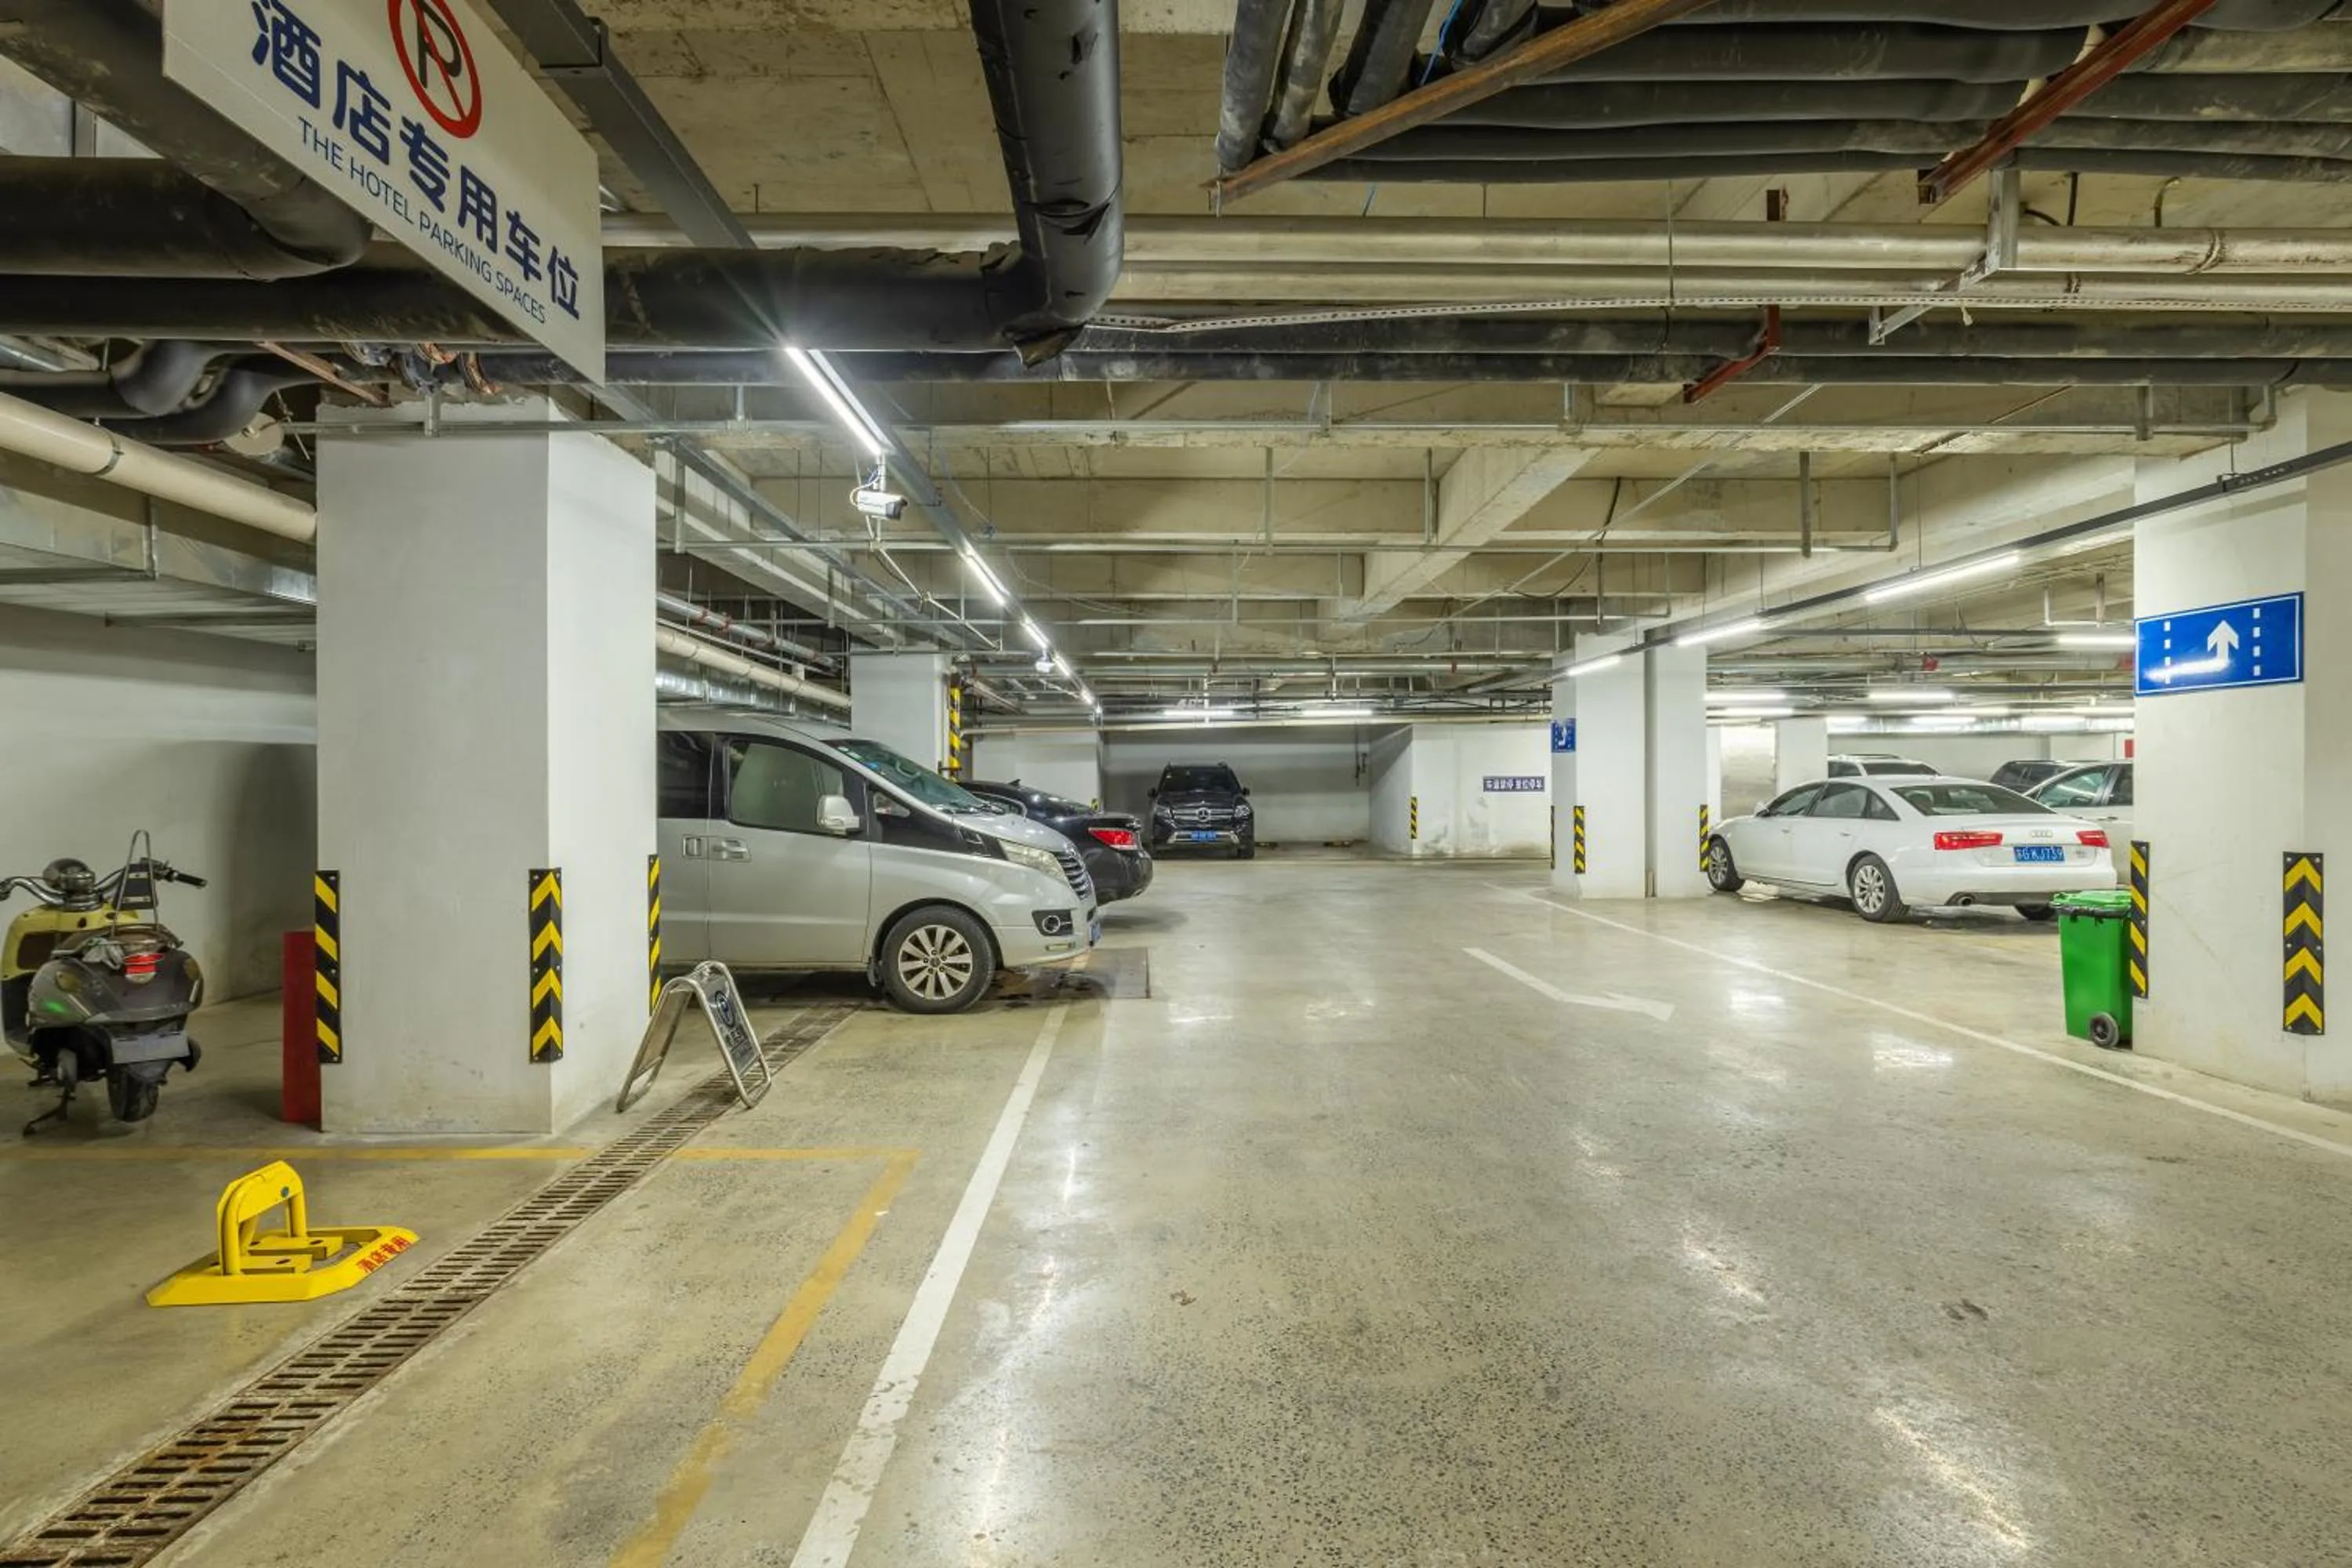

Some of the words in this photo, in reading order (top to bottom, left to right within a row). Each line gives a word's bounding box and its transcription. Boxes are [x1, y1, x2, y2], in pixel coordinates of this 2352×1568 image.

[252, 0, 579, 320] 酒店专用车位
[299, 116, 343, 171] THE
[350, 157, 414, 224] HOTEL
[419, 211, 492, 283] PARKING
[495, 271, 545, 324] SPACES
